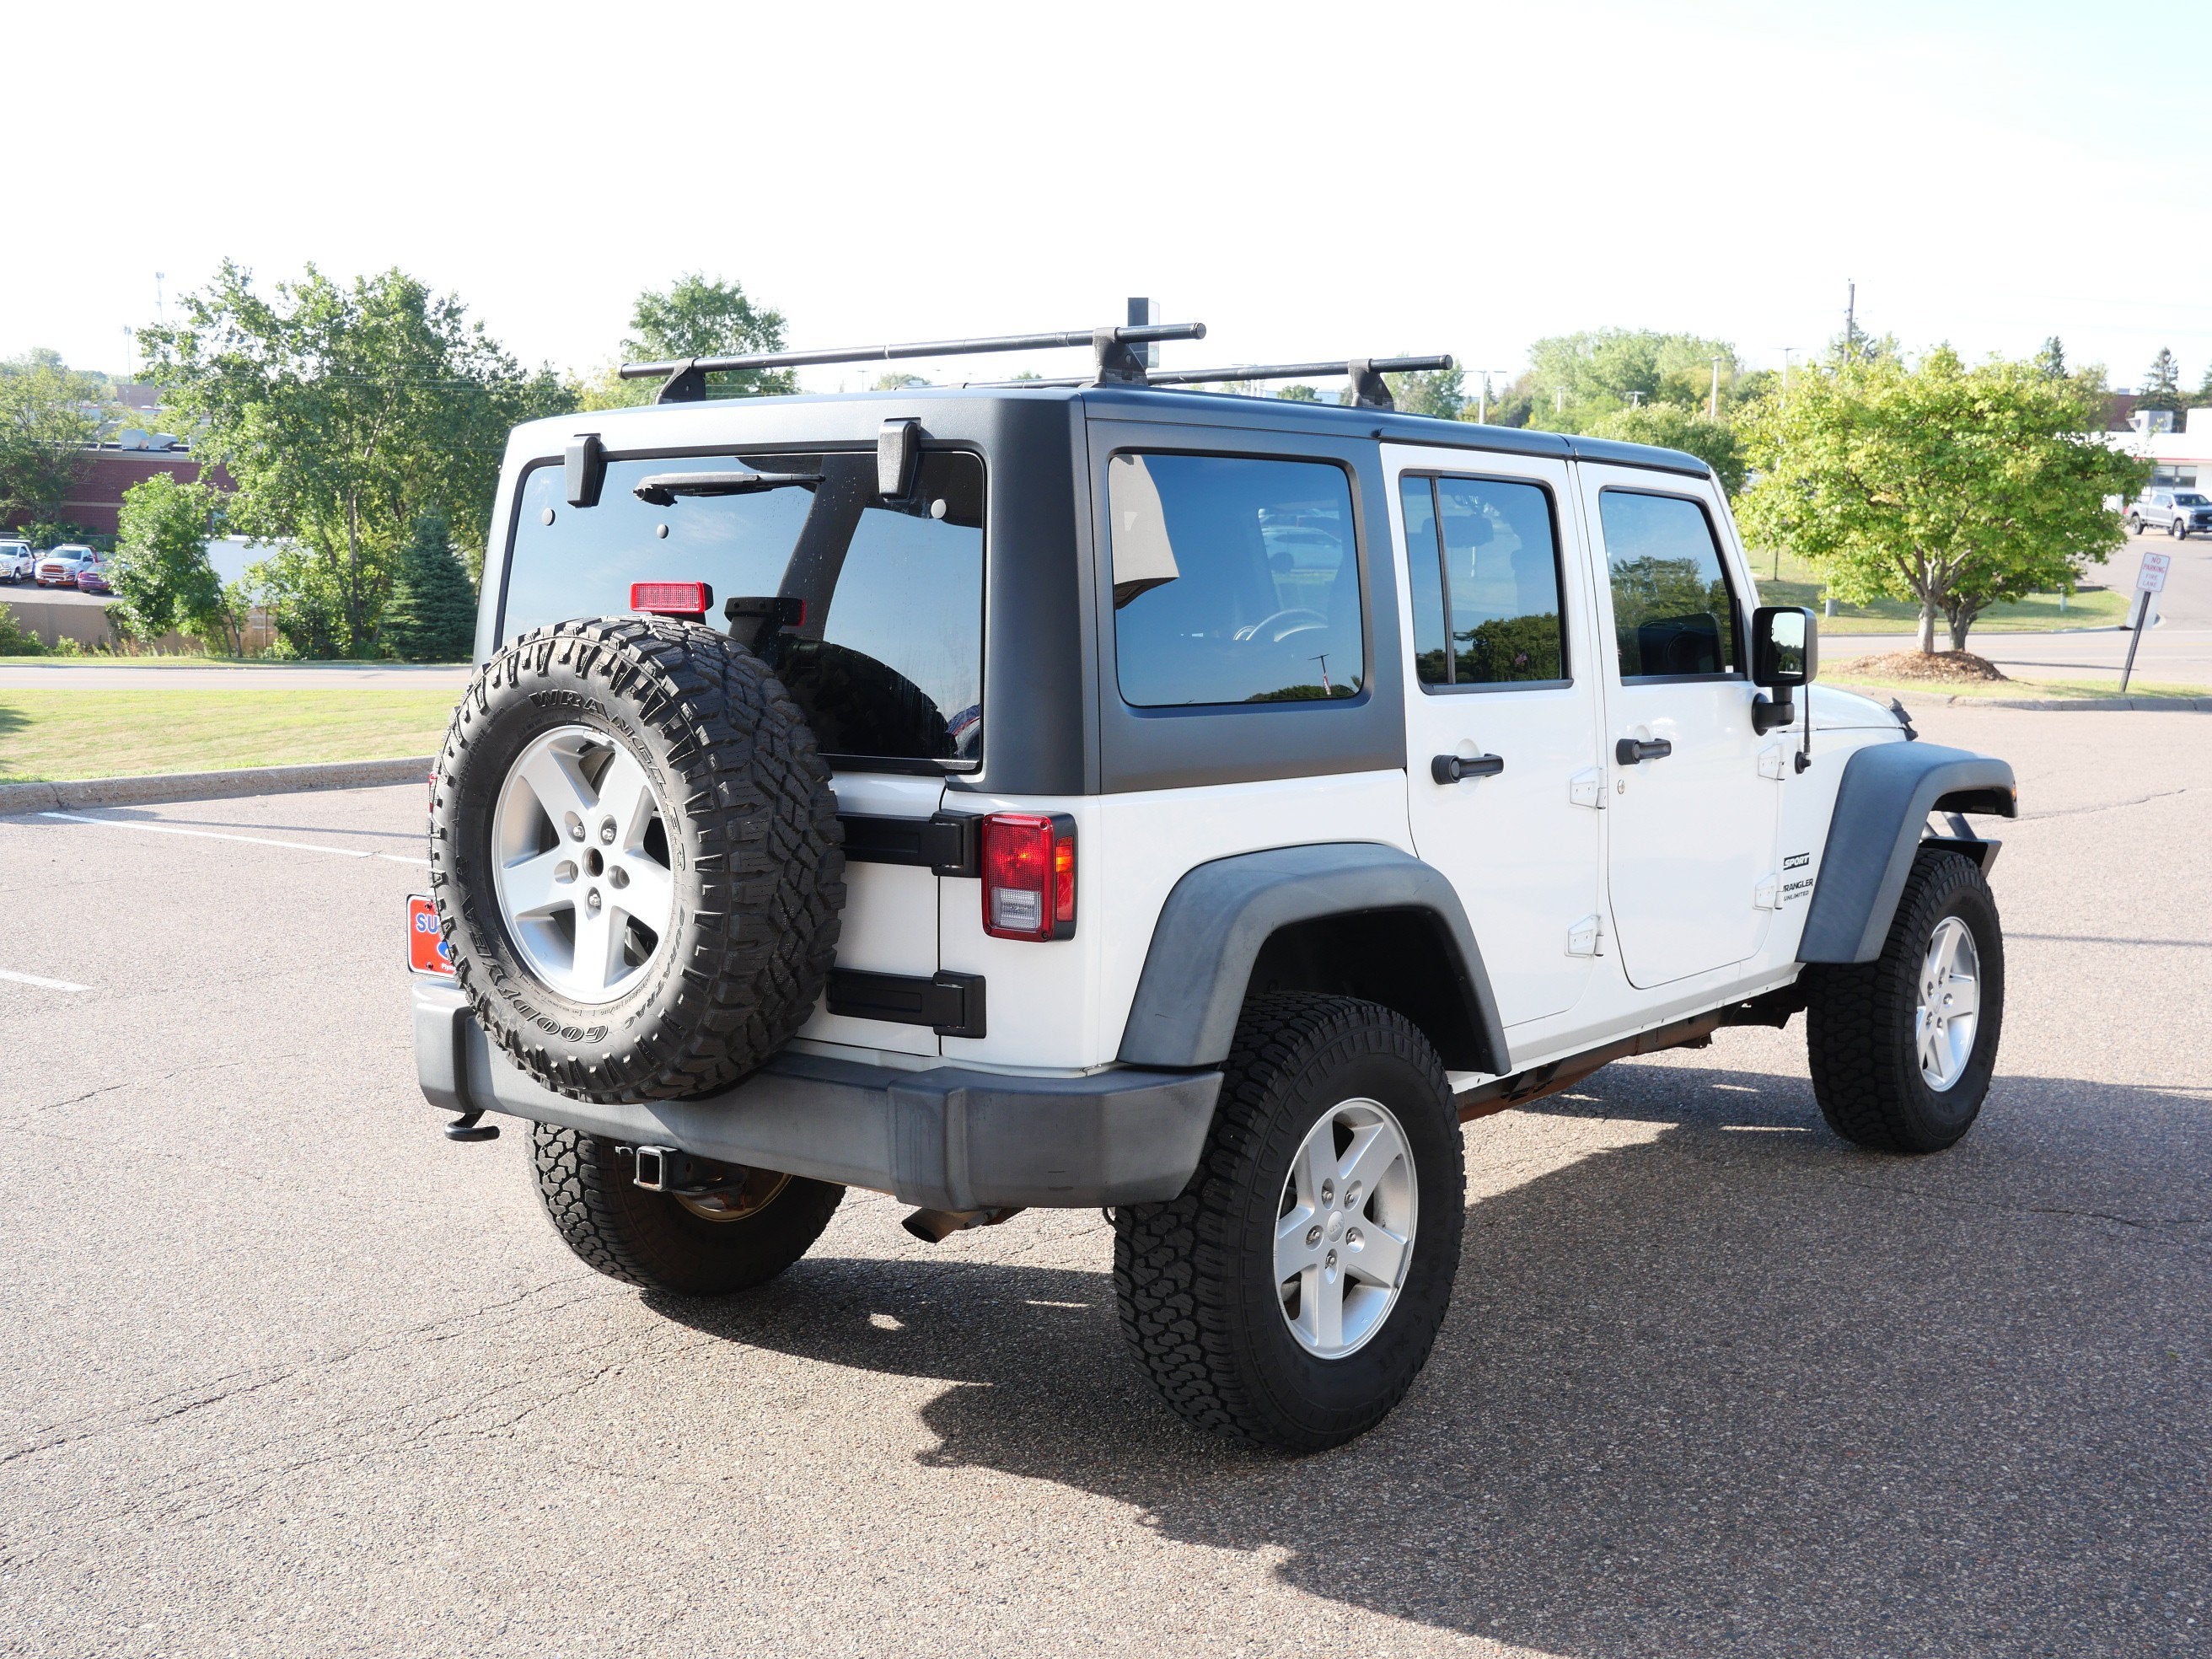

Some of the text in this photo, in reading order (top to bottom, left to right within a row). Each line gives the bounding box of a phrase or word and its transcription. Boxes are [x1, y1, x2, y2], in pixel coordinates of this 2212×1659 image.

[2151, 556, 2161, 565] NO
[2142, 564, 2166, 573] PARKING
[1783, 854, 1810, 869] SPORT
[1782, 878, 1814, 892] RANGLER
[1783, 890, 1810, 901] UNLIMITED
